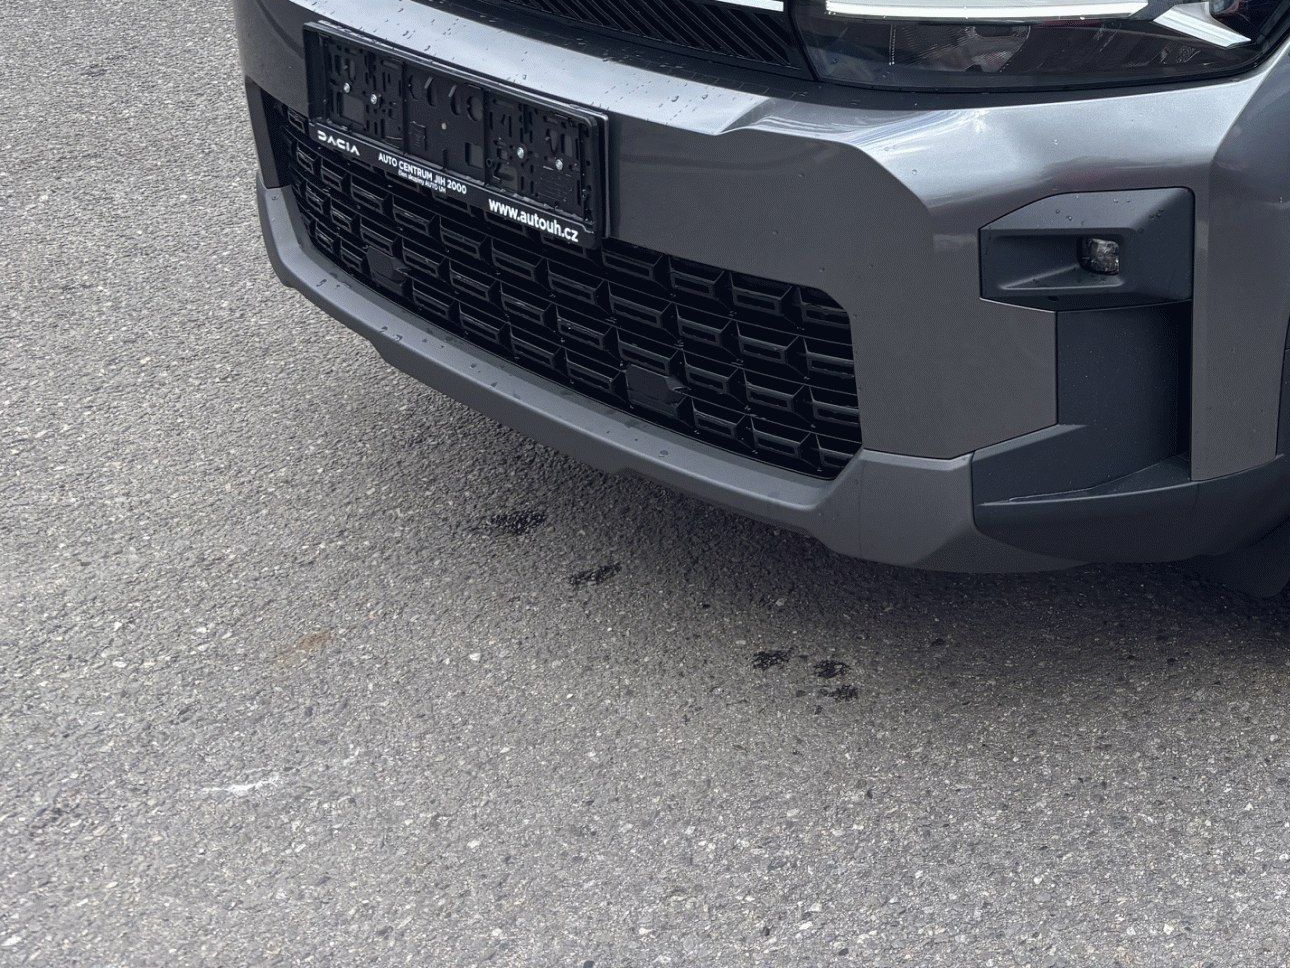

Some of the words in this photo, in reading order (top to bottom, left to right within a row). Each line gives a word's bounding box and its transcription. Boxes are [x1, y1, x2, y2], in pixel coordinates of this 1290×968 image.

[317, 130, 360, 156] DACIA
[378, 152, 398, 167] AUTO
[398, 160, 433, 181] CENTRUM
[446, 179, 467, 195] 2000
[488, 198, 579, 243] www.autouh.cz
